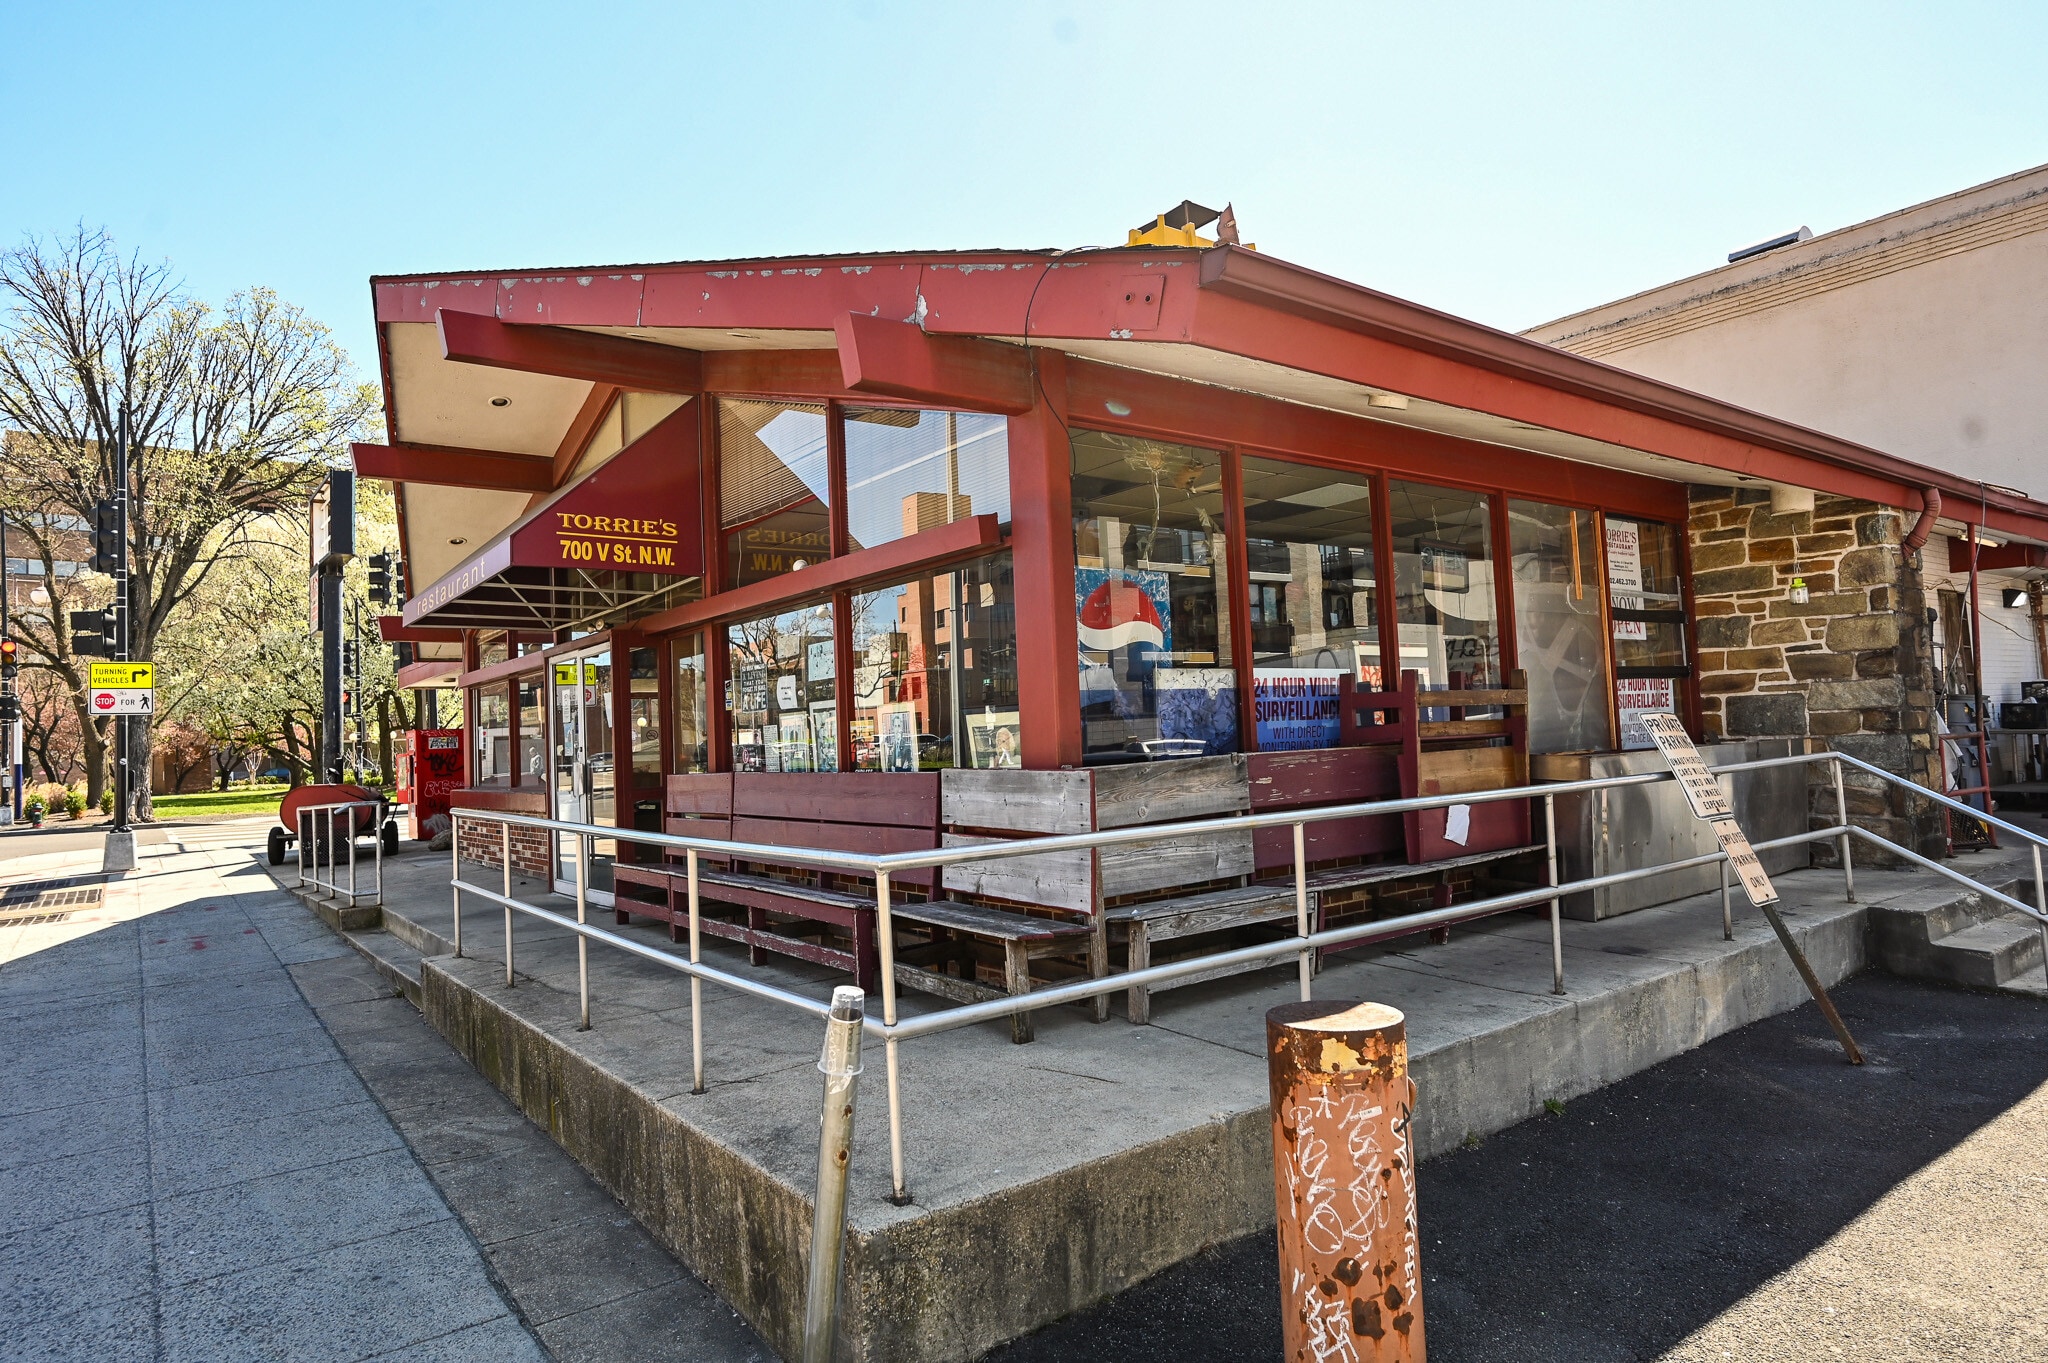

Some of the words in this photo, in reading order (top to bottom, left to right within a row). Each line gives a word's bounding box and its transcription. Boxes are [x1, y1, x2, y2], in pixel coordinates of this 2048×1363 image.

[556, 512, 678, 536] TORRIE'S
[1606, 528, 1636, 544] ORRIE'S
[560, 540, 592, 560] 700
[596, 542, 610, 562] V
[613, 544, 636, 564] St.
[640, 546, 675, 566] N.W.
[417, 557, 486, 616] restaurant
[1612, 596, 1638, 610] NOW
[1254, 678, 1268, 698] 24
[1272, 677, 1306, 698] HOUR
[1617, 679, 1626, 691] 24
[1628, 678, 1646, 691] HOUR
[1649, 678, 1669, 691] VIDEO
[1618, 693, 1669, 709] SURVEILLANCE
[1273, 726, 1294, 739] WITH
[1298, 725, 1326, 738] DIRECT
[1645, 718, 1684, 733] PRIVATE
[1659, 735, 1694, 750] PARKING
[1678, 768, 1692, 777] CARS
[1686, 779, 1704, 788] TOWED
[1705, 778, 1716, 786] AWAY
[1695, 790, 1702, 798] AT
[1702, 788, 1721, 797] OWNERS
[1703, 799, 1726, 810] EXPENSE
[1720, 831, 1746, 846] EMPLOYEE
[1732, 853, 1758, 867] PARKING
[1750, 875, 1766, 888] ONLY
